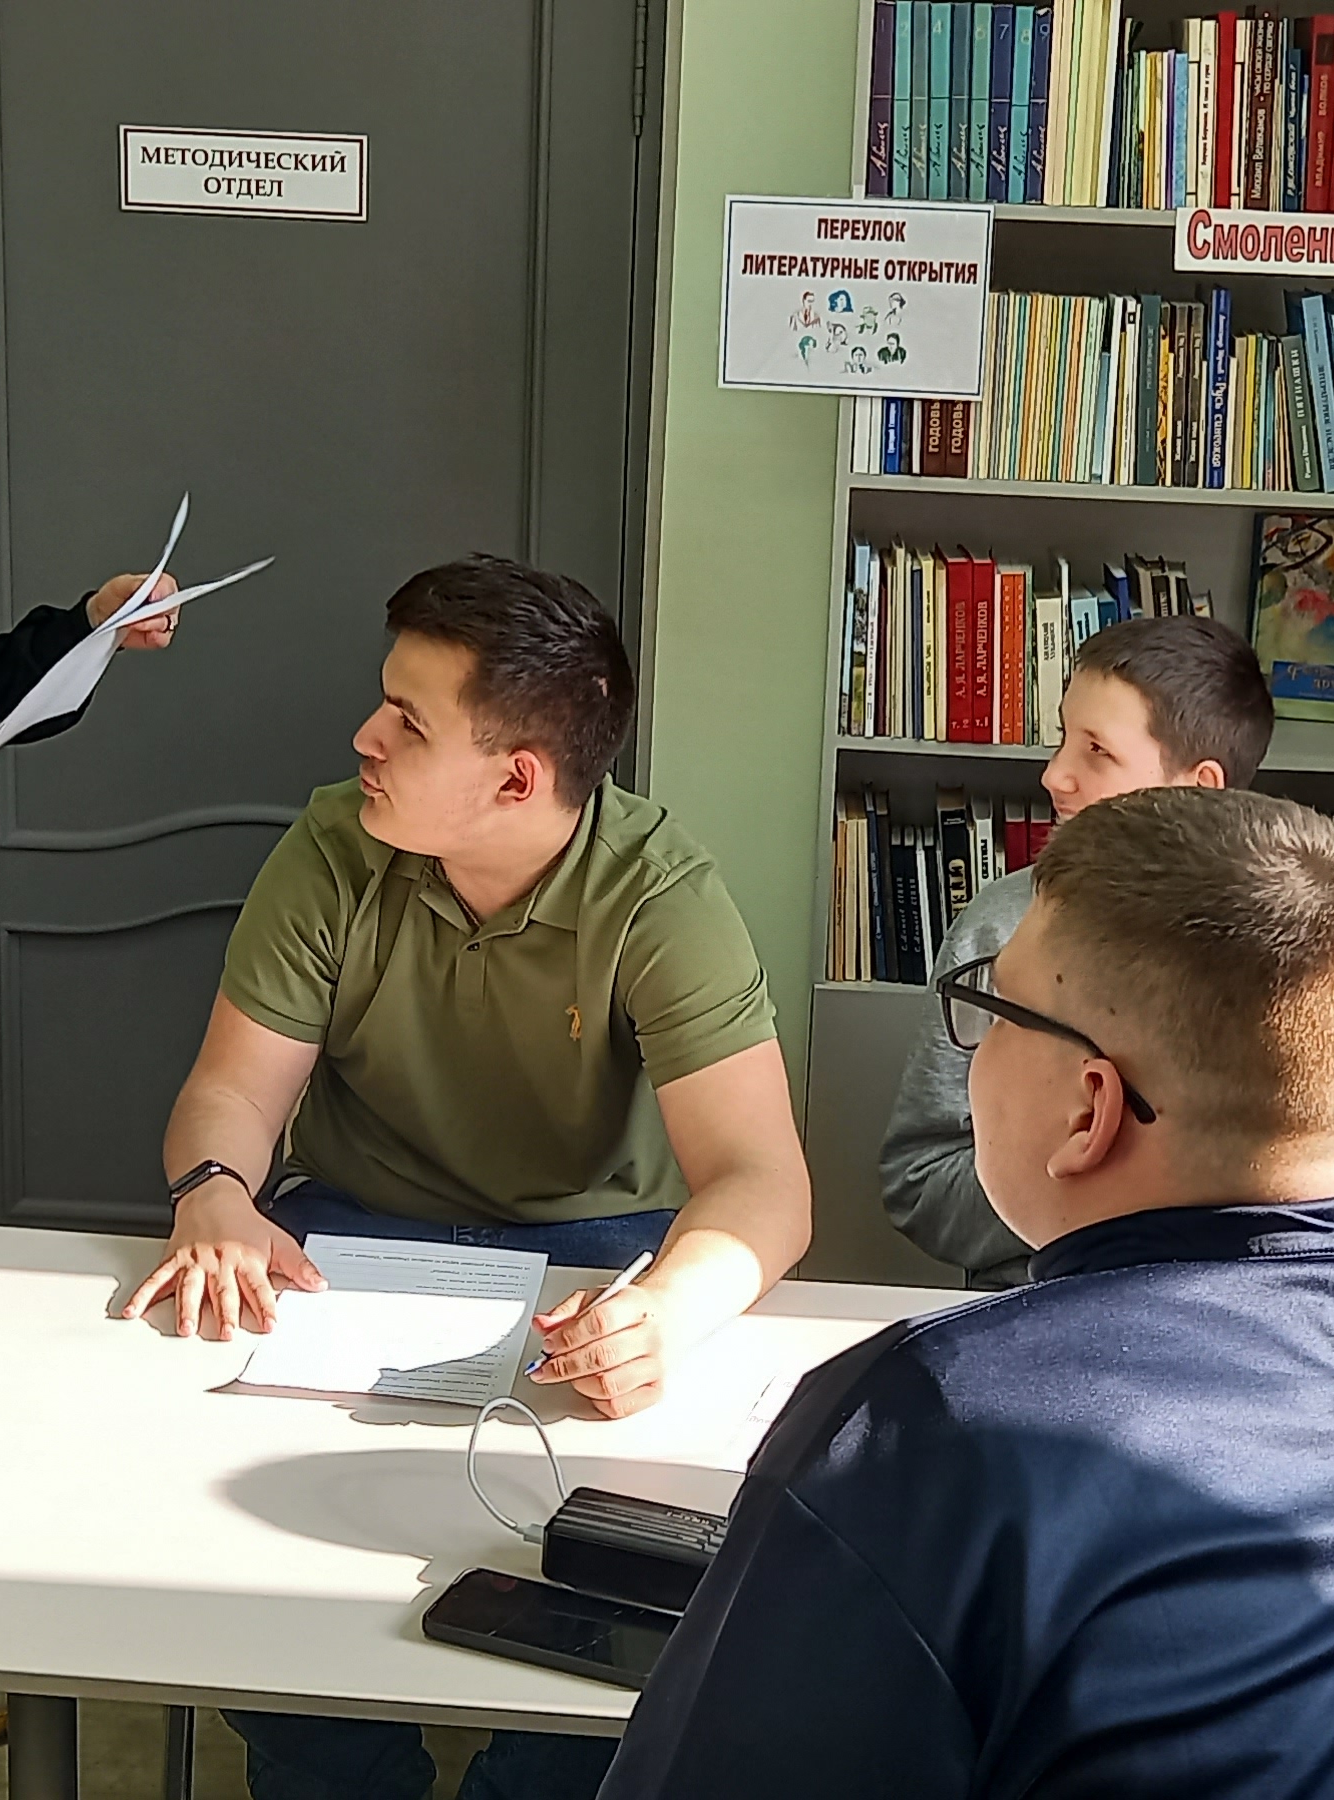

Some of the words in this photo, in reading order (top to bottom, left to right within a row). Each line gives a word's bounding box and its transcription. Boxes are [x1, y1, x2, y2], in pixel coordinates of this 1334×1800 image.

[1253, 109, 1266, 160] Великанов
[140, 146, 347, 173] МЕТОДИЧЕСКИЙ
[203, 176, 284, 198] ОТДЕЛ
[1251, 162, 1263, 198] Михаил
[817, 218, 906, 242] ПЕРЕУЛОК
[742, 254, 879, 280] ЛИТЕРАТУРНЫЕ
[884, 259, 978, 284] ОТКРЫТИЯ
[1211, 383, 1226, 409] Русь
[1290, 350, 1305, 417] ПЯТНАШКИ
[955, 601, 965, 670] ЛАРЧЕНКОВ
[976, 601, 987, 669] ЛАРЧЕНКОВ
